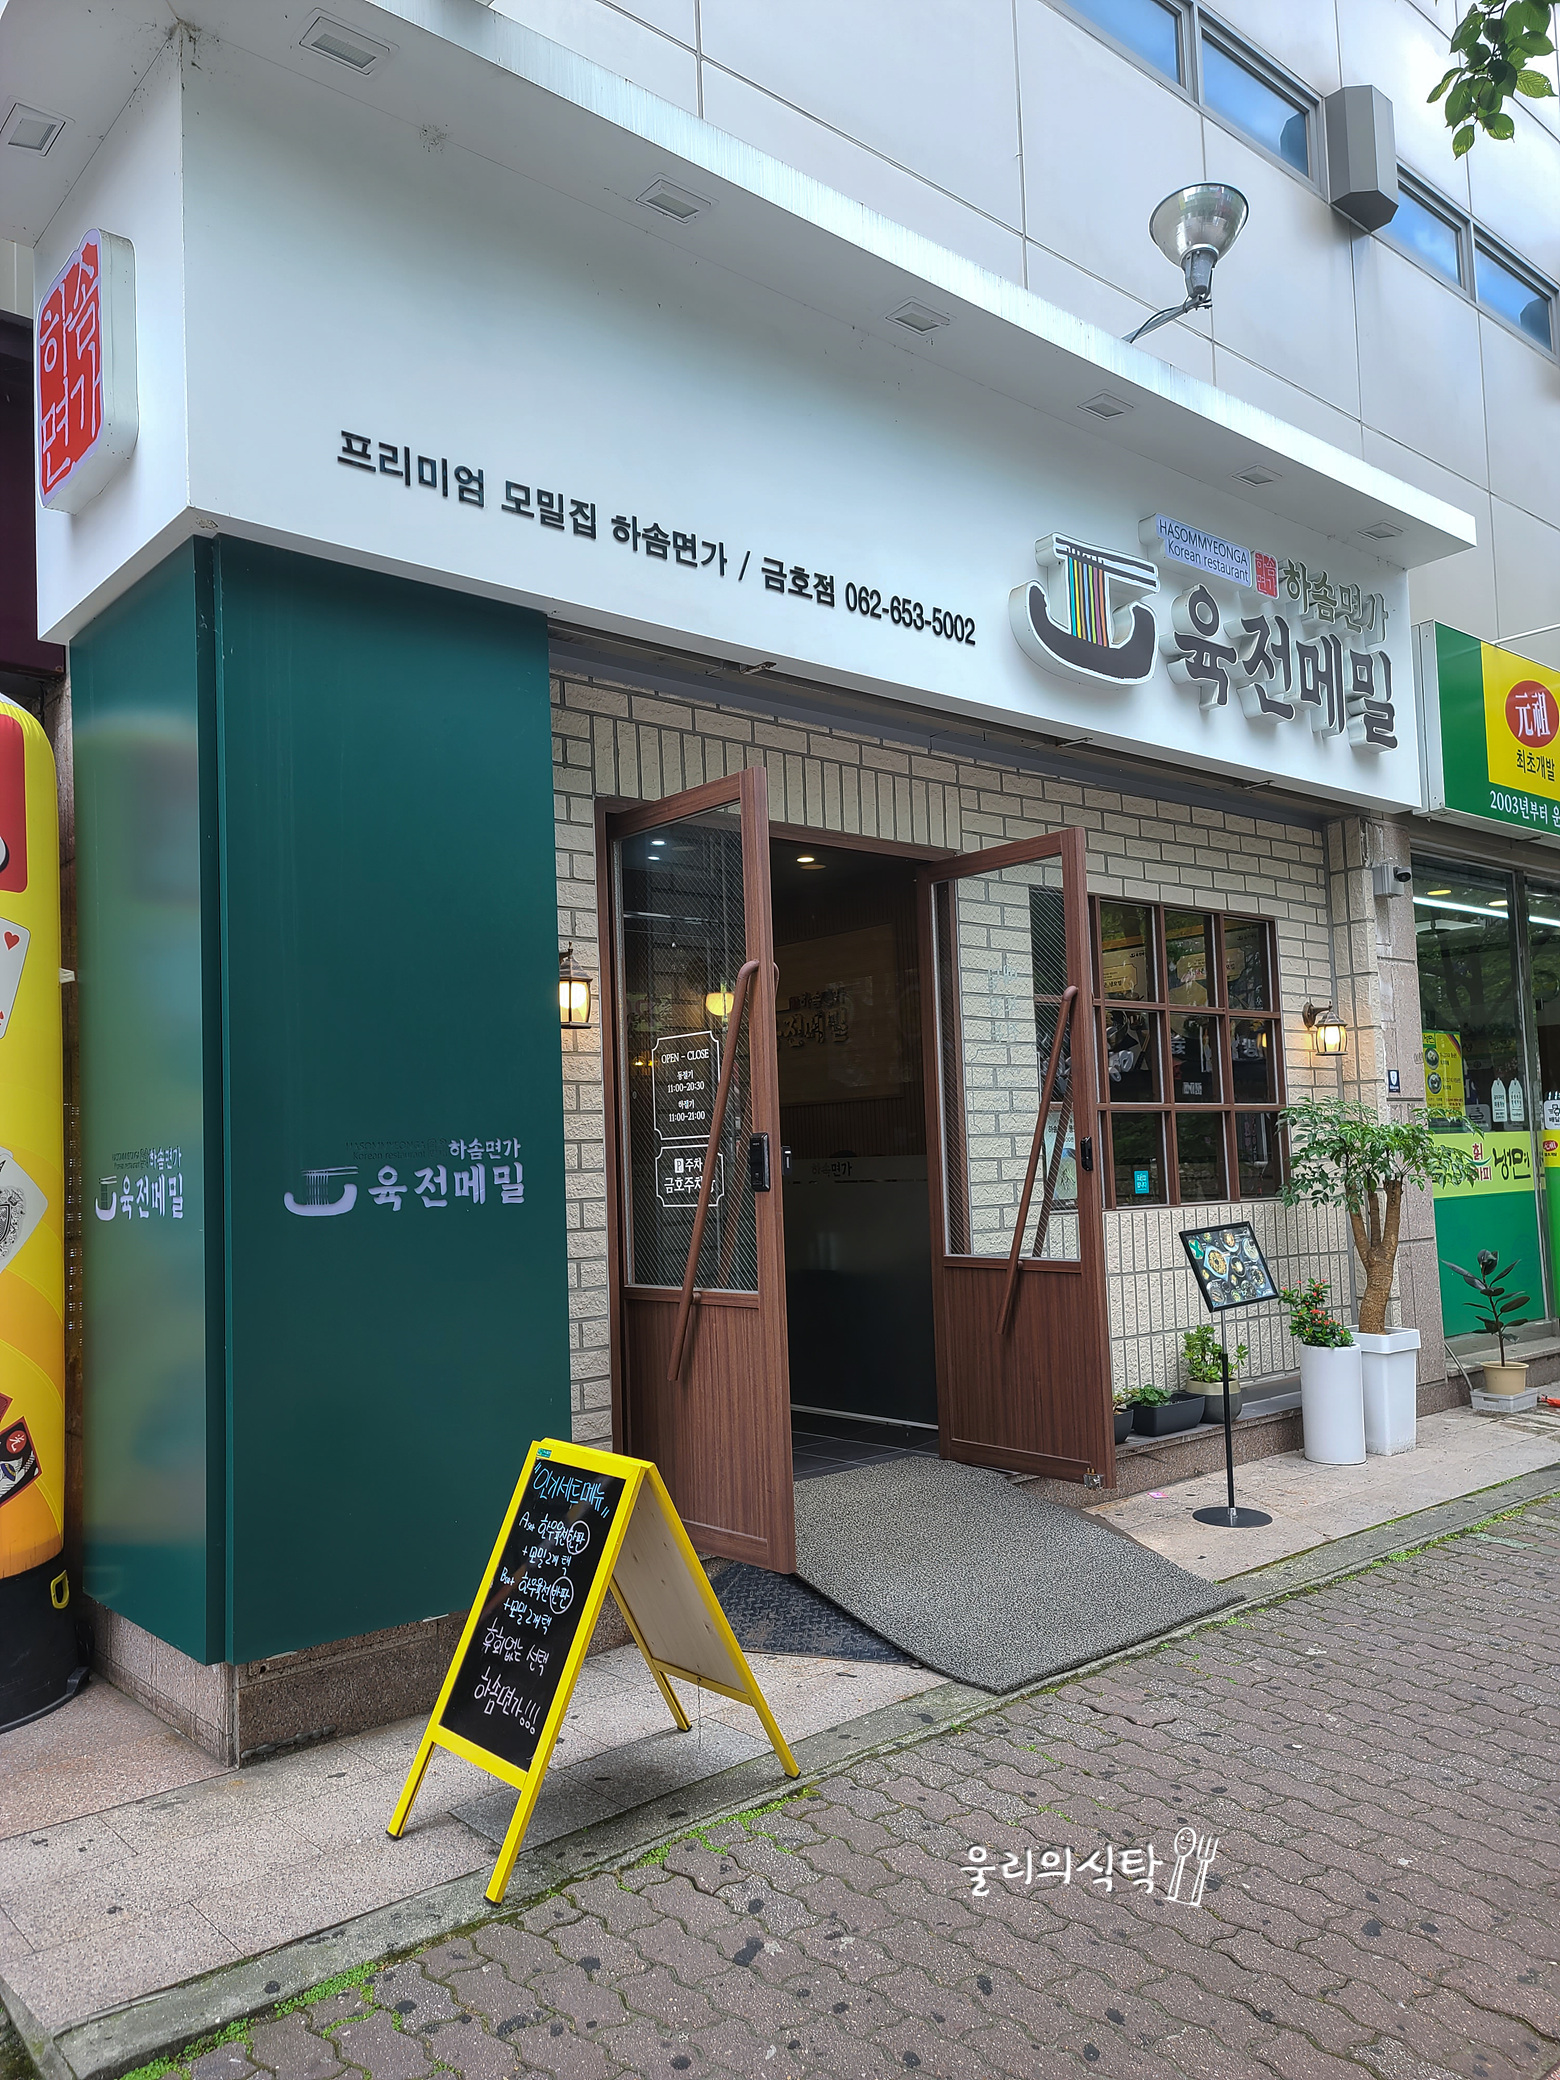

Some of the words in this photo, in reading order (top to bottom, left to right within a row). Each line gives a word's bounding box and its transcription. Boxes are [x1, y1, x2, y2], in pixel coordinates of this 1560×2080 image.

[337, 429, 485, 508] 프리미엄
[501, 479, 597, 540] 모밀집
[611, 515, 728, 577] 하솜면가
[761, 556, 836, 608] 금호점
[845, 581, 977, 646] 062-653-5002
[1159, 518, 1248, 566] HASOMMYEONGA
[1168, 540, 1201, 564] Korean
[1203, 555, 1249, 583] restaurant
[1286, 557, 1390, 642] 하솜면가
[1174, 584, 1399, 750] 육전메밀
[1514, 691, 1551, 738] 元祖
[1516, 749, 1555, 782] 최초개발
[1489, 790, 1549, 826] 2003년부터
[661, 1052, 680, 1064] OPEN
[686, 1048, 710, 1061] CLOSE
[667, 1080, 705, 1094] 11:00-20:30
[668, 1110, 706, 1123] 11:00-21:00
[149, 1146, 182, 1170] 하솜면가
[448, 1137, 521, 1161] 하솜면가
[685, 1157, 704, 1173] 주차
[1492, 1147, 1531, 1181] 냉면
[119, 1172, 184, 1220] 육전메밀
[367, 1161, 525, 1211] 육전메밀
[663, 1175, 716, 1195] 금호주차
[525, 1644, 551, 1677] 선택
